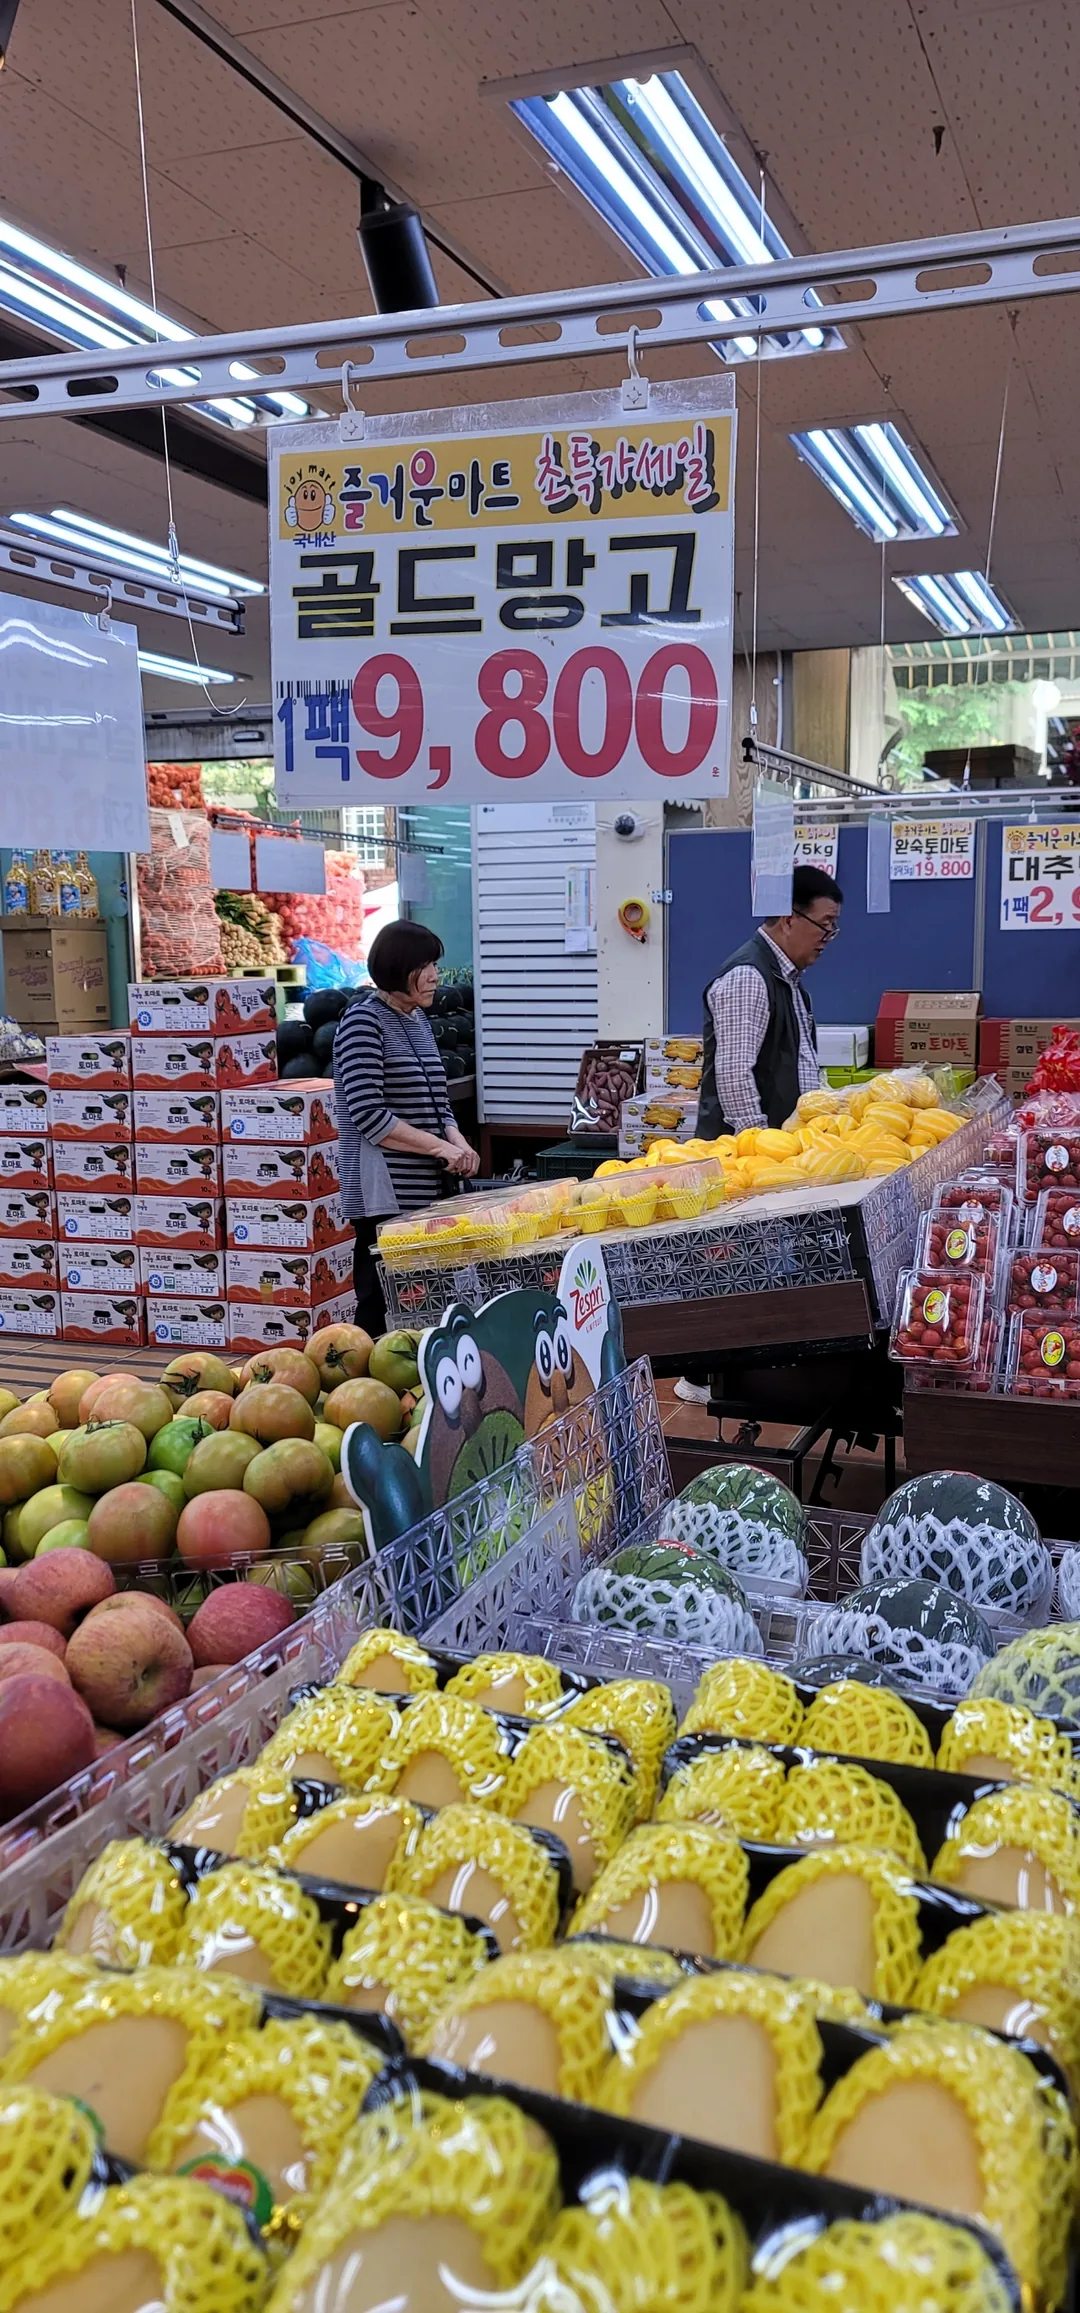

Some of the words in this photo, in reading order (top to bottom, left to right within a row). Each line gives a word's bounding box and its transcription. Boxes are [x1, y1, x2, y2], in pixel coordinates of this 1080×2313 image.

[284, 468, 303, 494] joy
[308, 464, 336, 491] mart
[339, 448, 520, 532] 즐거운마트
[535, 421, 717, 512] 초특가세일
[293, 531, 336, 549] 국내산
[292, 532, 703, 640] 골드망고
[277, 688, 350, 782] 1팩
[352, 642, 719, 790] 9,800
[794, 842, 834, 857] /5kg
[895, 836, 969, 855] 완숙토마토
[1009, 855, 1080, 881] 대추
[1003, 896, 1029, 923] 1팩
[894, 1020, 905, 1059] TOMATO
[928, 1037, 969, 1050] 토마토
[1000, 1023, 1010, 1062] TOMATO
[78, 1062, 101, 1070] 토마토
[164, 1063, 188, 1071] 토마토
[167, 1116, 190, 1124] 토마토
[1, 1160, 22, 1168] 토마토
[83, 1164, 106, 1172] 토마토
[166, 1168, 190, 1176] 토마토
[6, 1210, 27, 1218] 토마토
[165, 1220, 188, 1228] 토마토
[10, 1262, 32, 1270] 토마토
[569, 1279, 607, 1332] Zespri
[92, 1317, 114, 1325] 토마토
